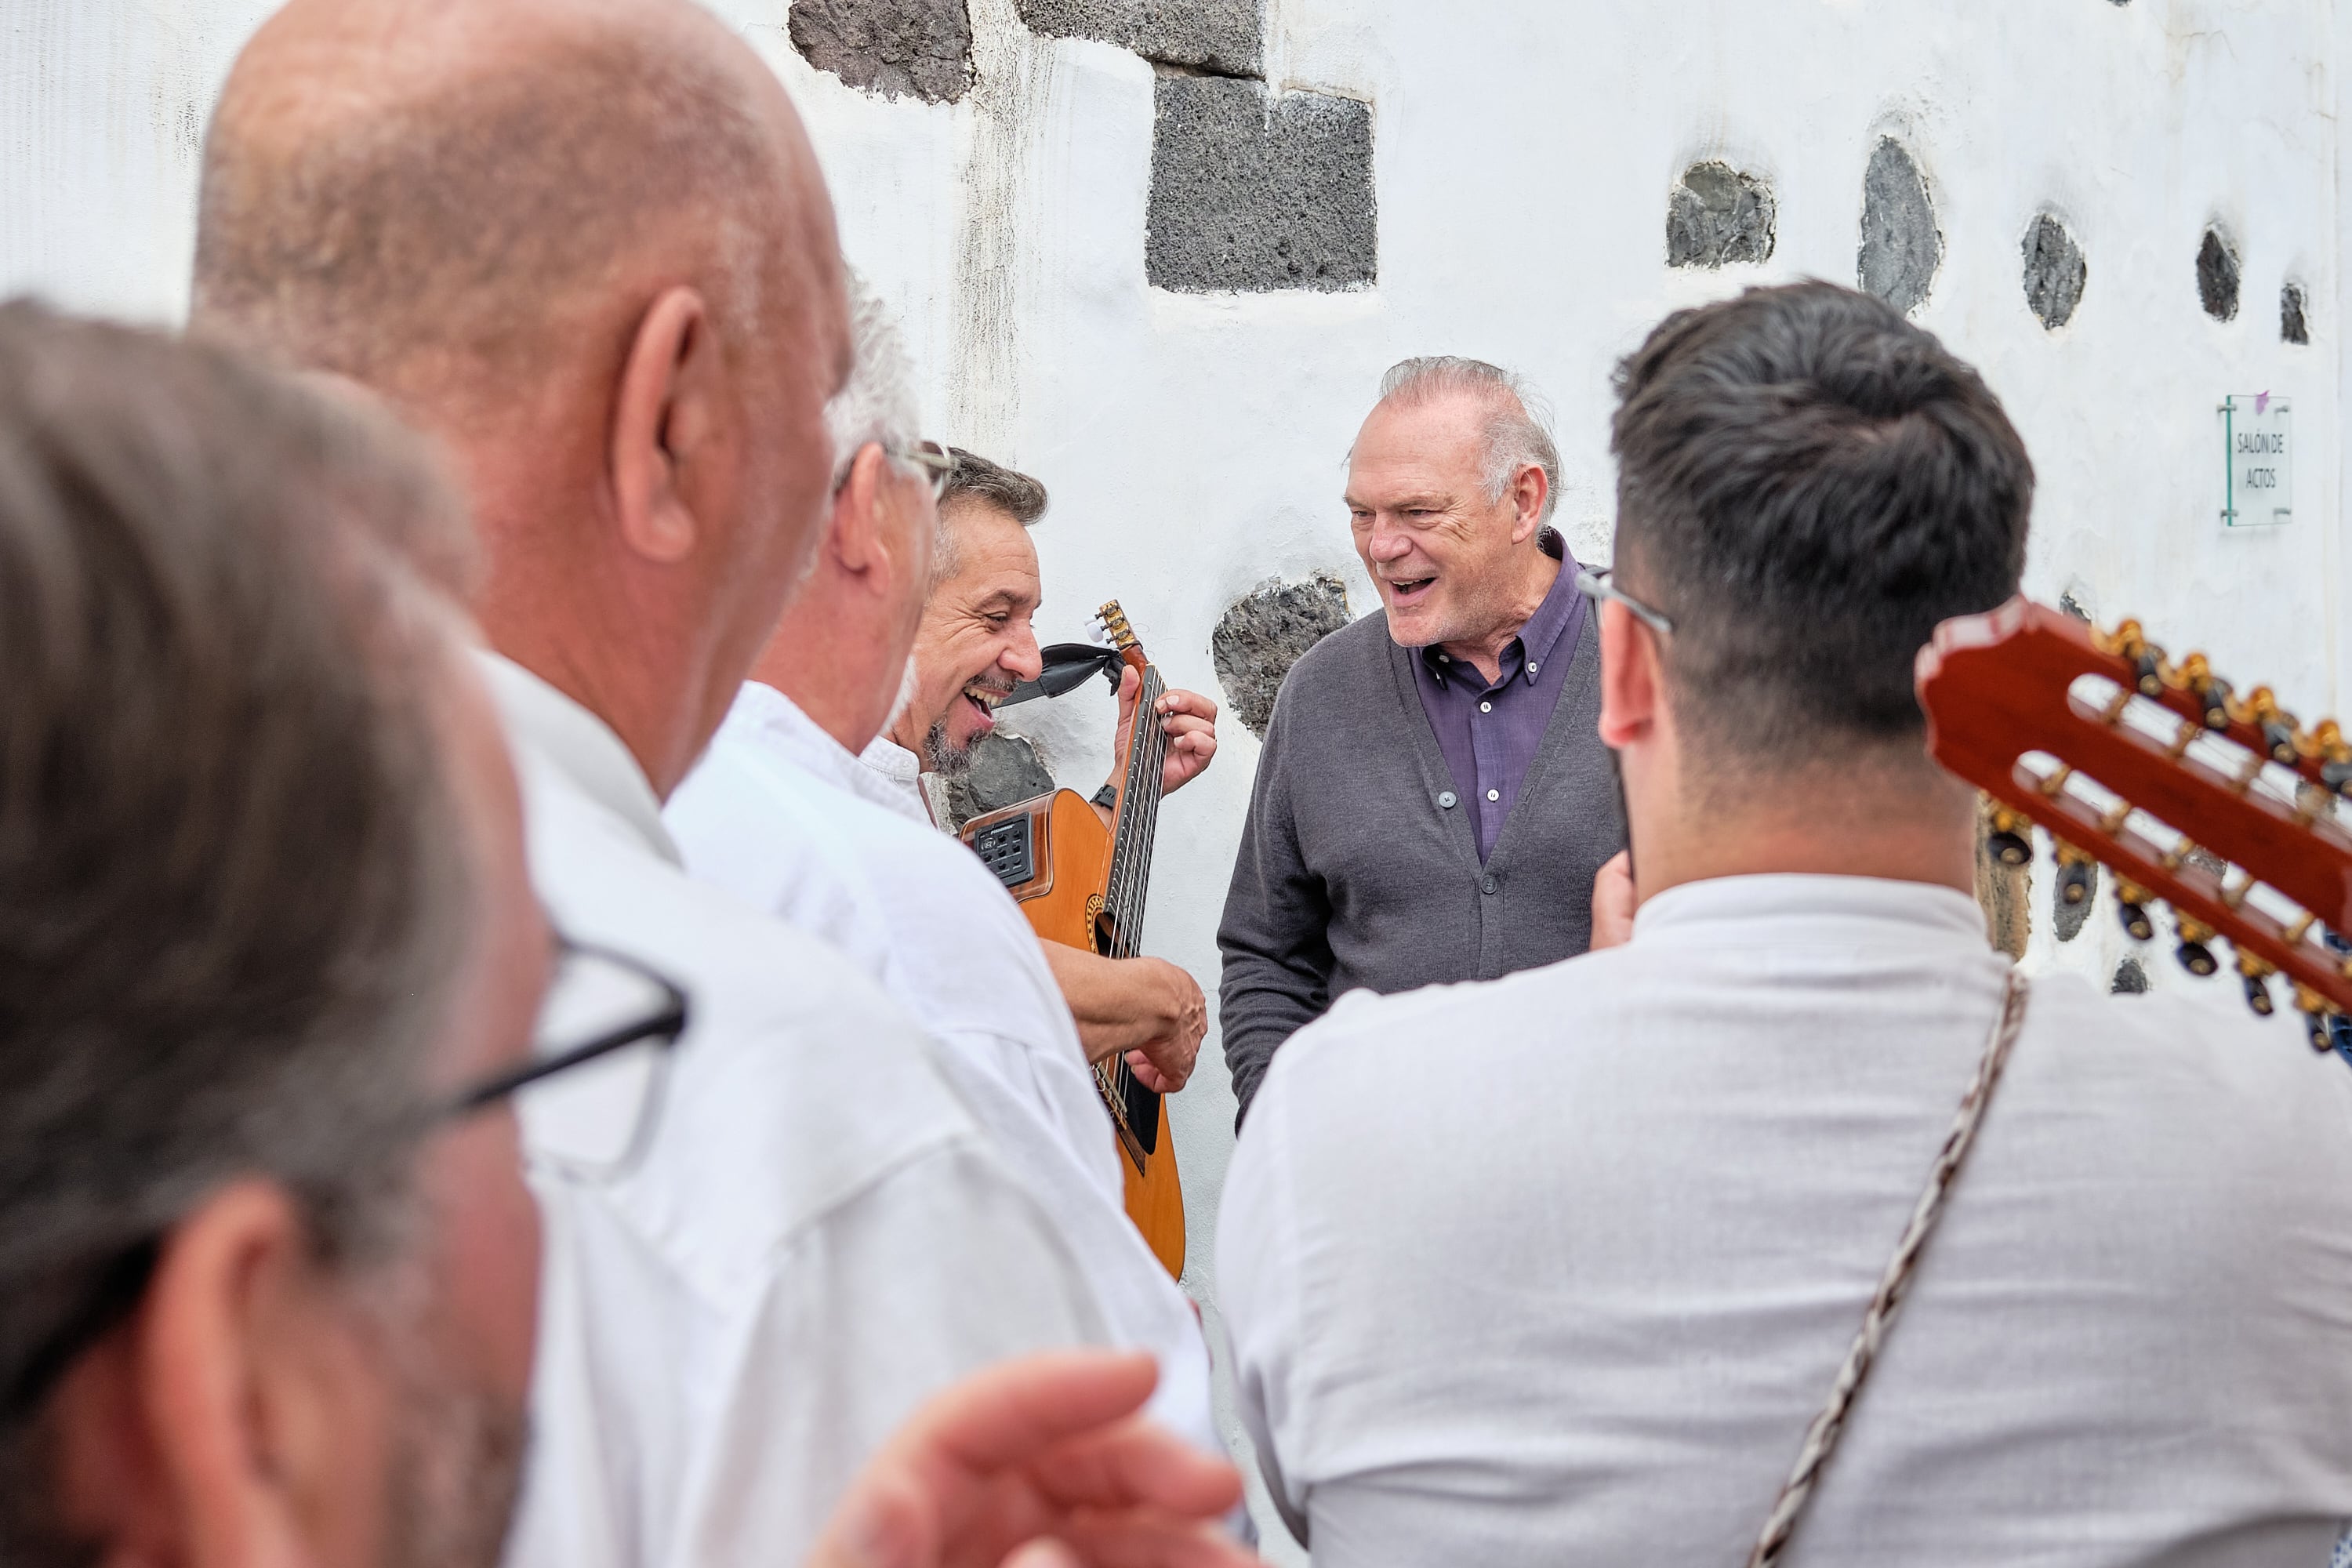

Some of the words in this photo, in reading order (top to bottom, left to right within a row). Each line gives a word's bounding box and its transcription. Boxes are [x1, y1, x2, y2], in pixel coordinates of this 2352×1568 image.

[2237, 429, 2269, 454] SALÓN
[2270, 433, 2284, 454] DE
[2246, 468, 2276, 488] ACTOS
